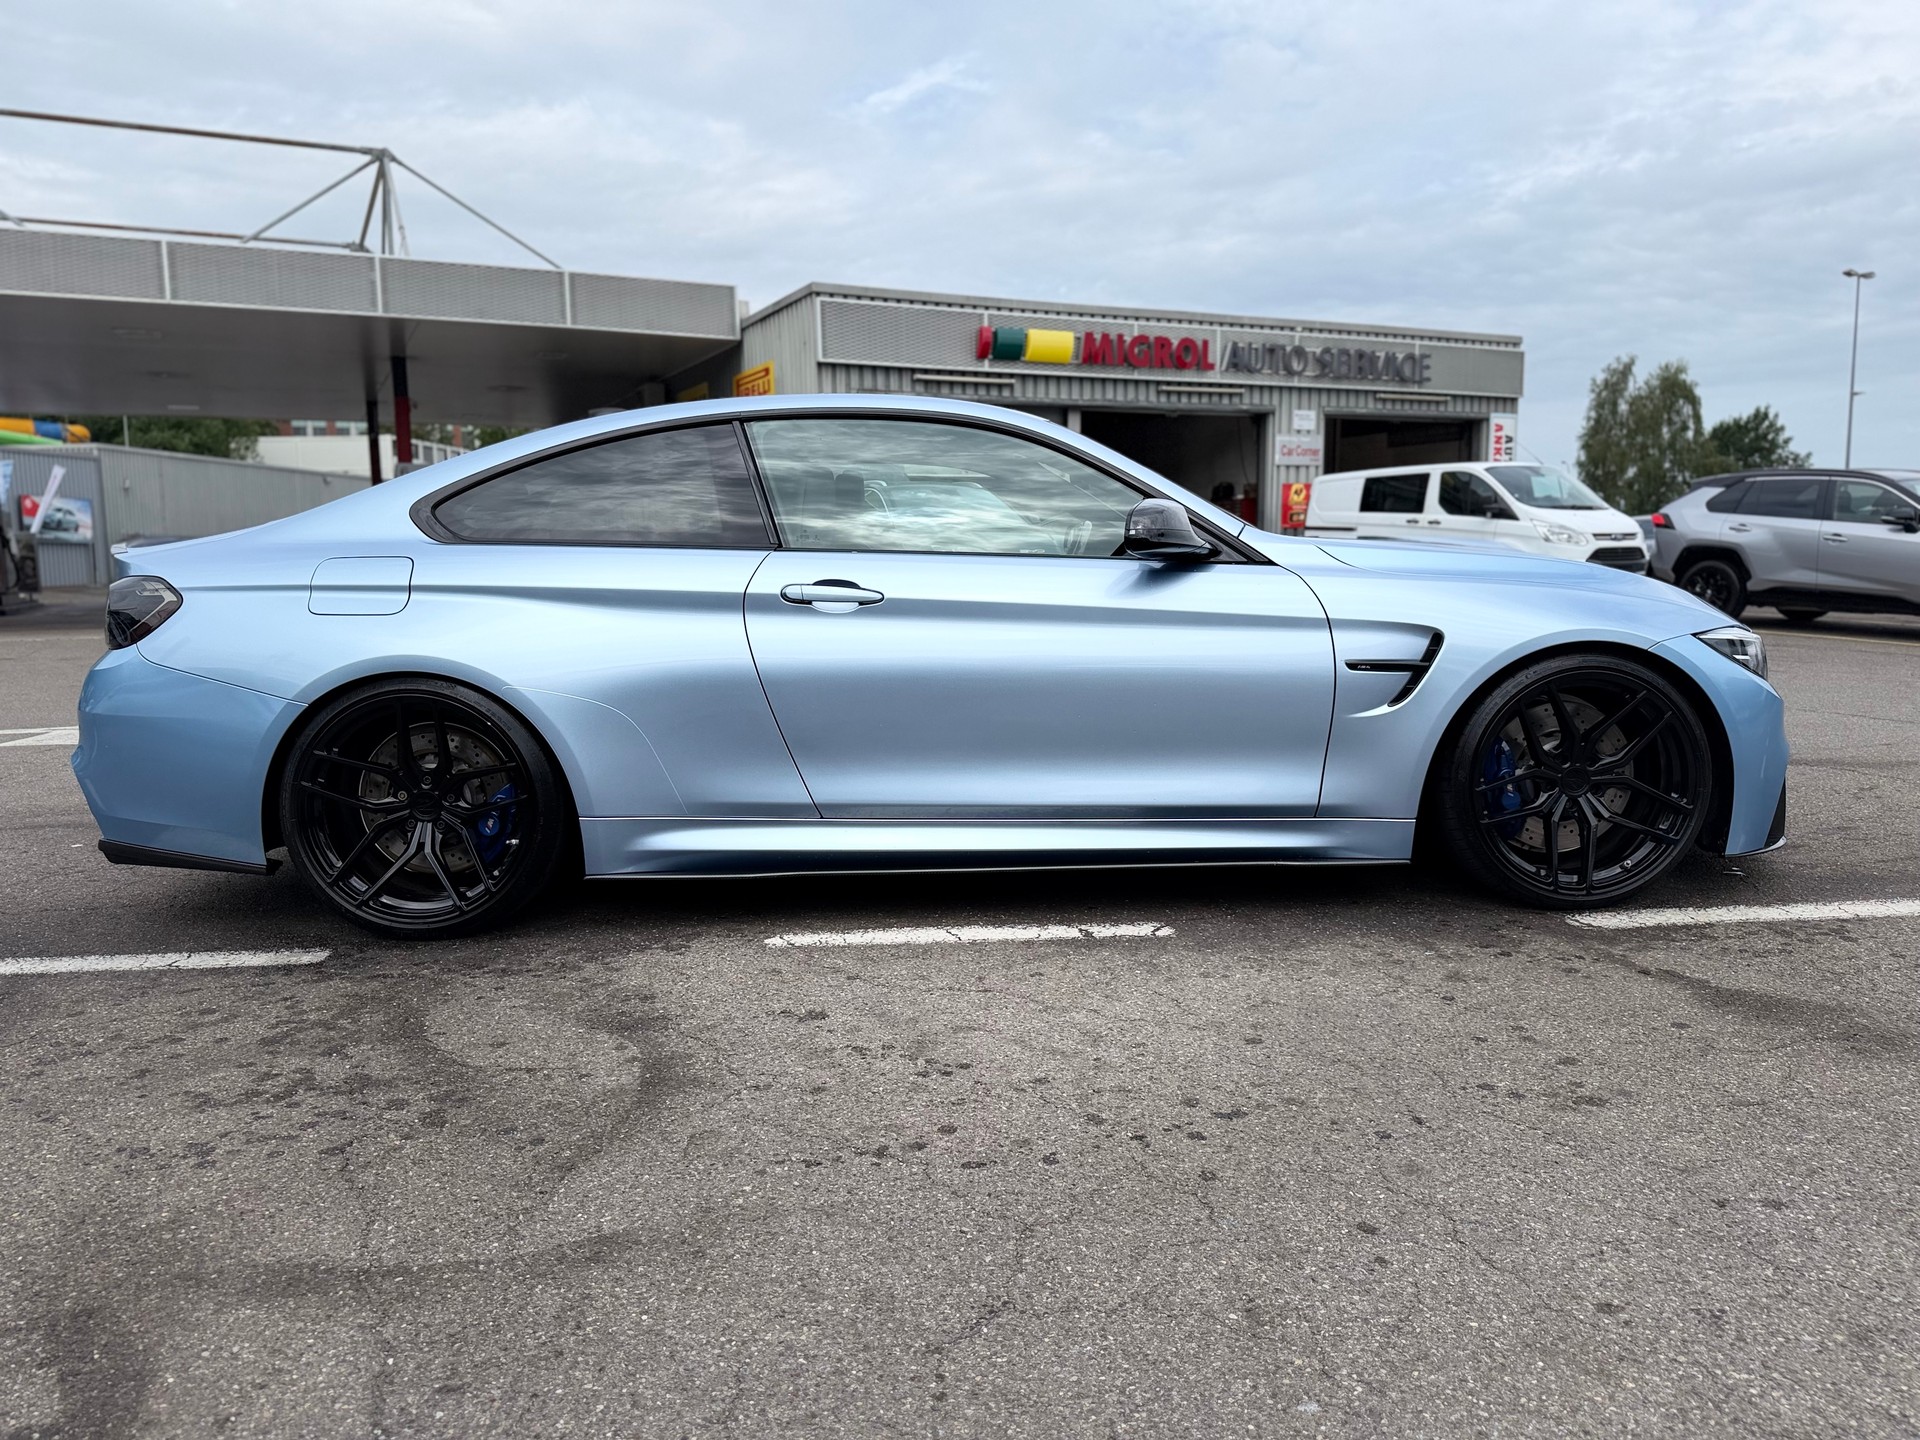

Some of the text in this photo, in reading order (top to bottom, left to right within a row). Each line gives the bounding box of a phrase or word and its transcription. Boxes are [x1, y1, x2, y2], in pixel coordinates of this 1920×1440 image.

[1082, 331, 1432, 384] MIGROL AUTO SERVICE
[1280, 444, 1294, 457] Car
